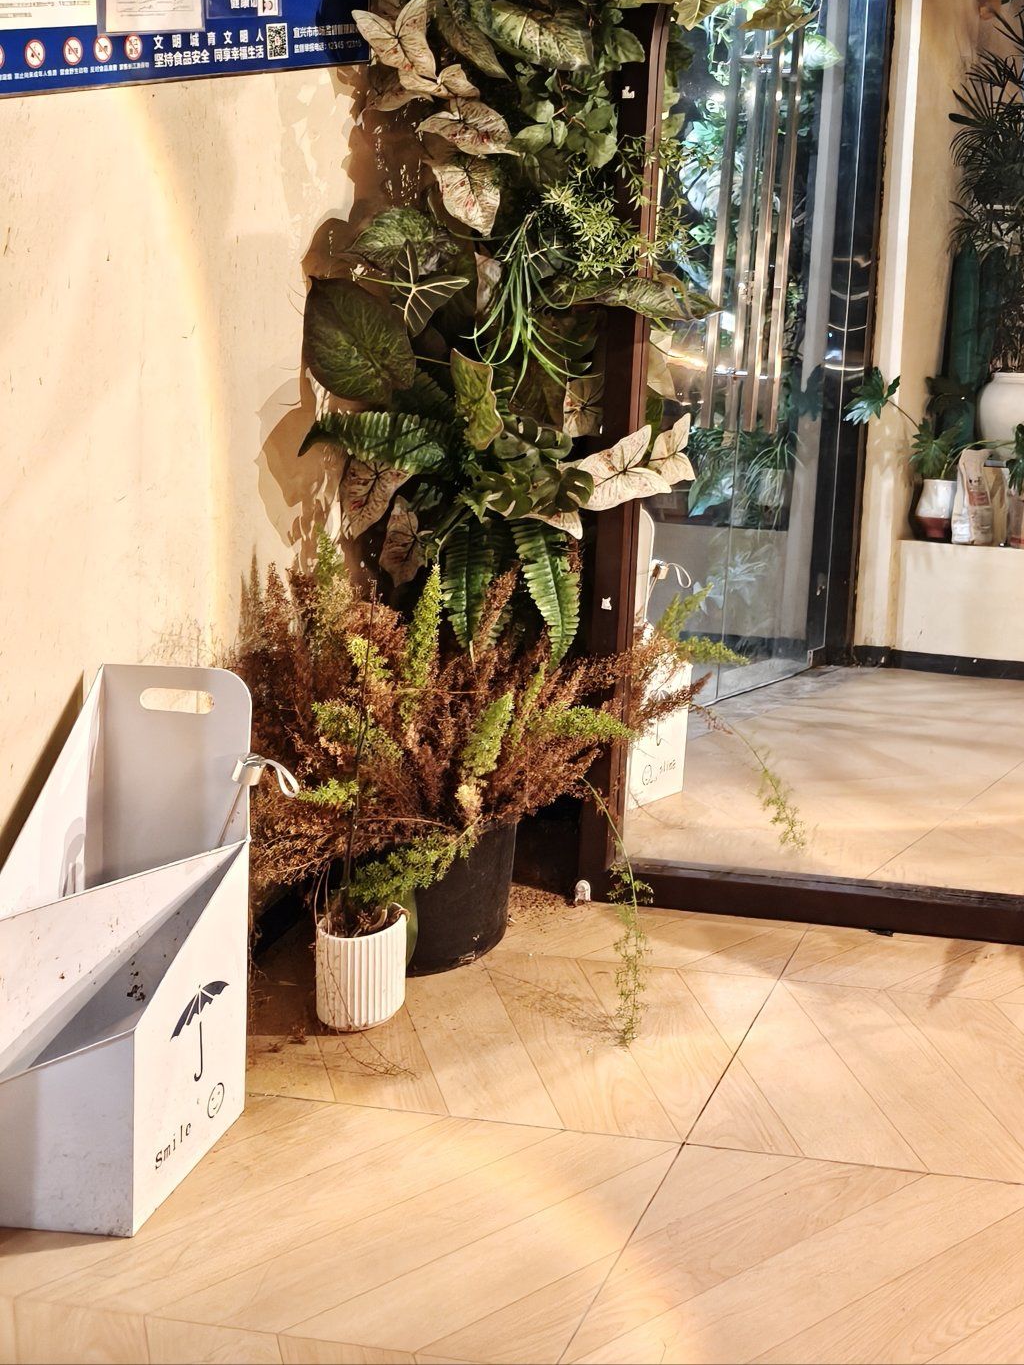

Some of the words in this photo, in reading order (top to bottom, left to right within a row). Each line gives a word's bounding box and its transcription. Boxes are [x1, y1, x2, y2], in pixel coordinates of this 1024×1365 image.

[153, 31, 265, 50] 文明城育文明人
[154, 49, 211, 68] 坚持食品安全
[213, 46, 265, 63] 同享幸福生活
